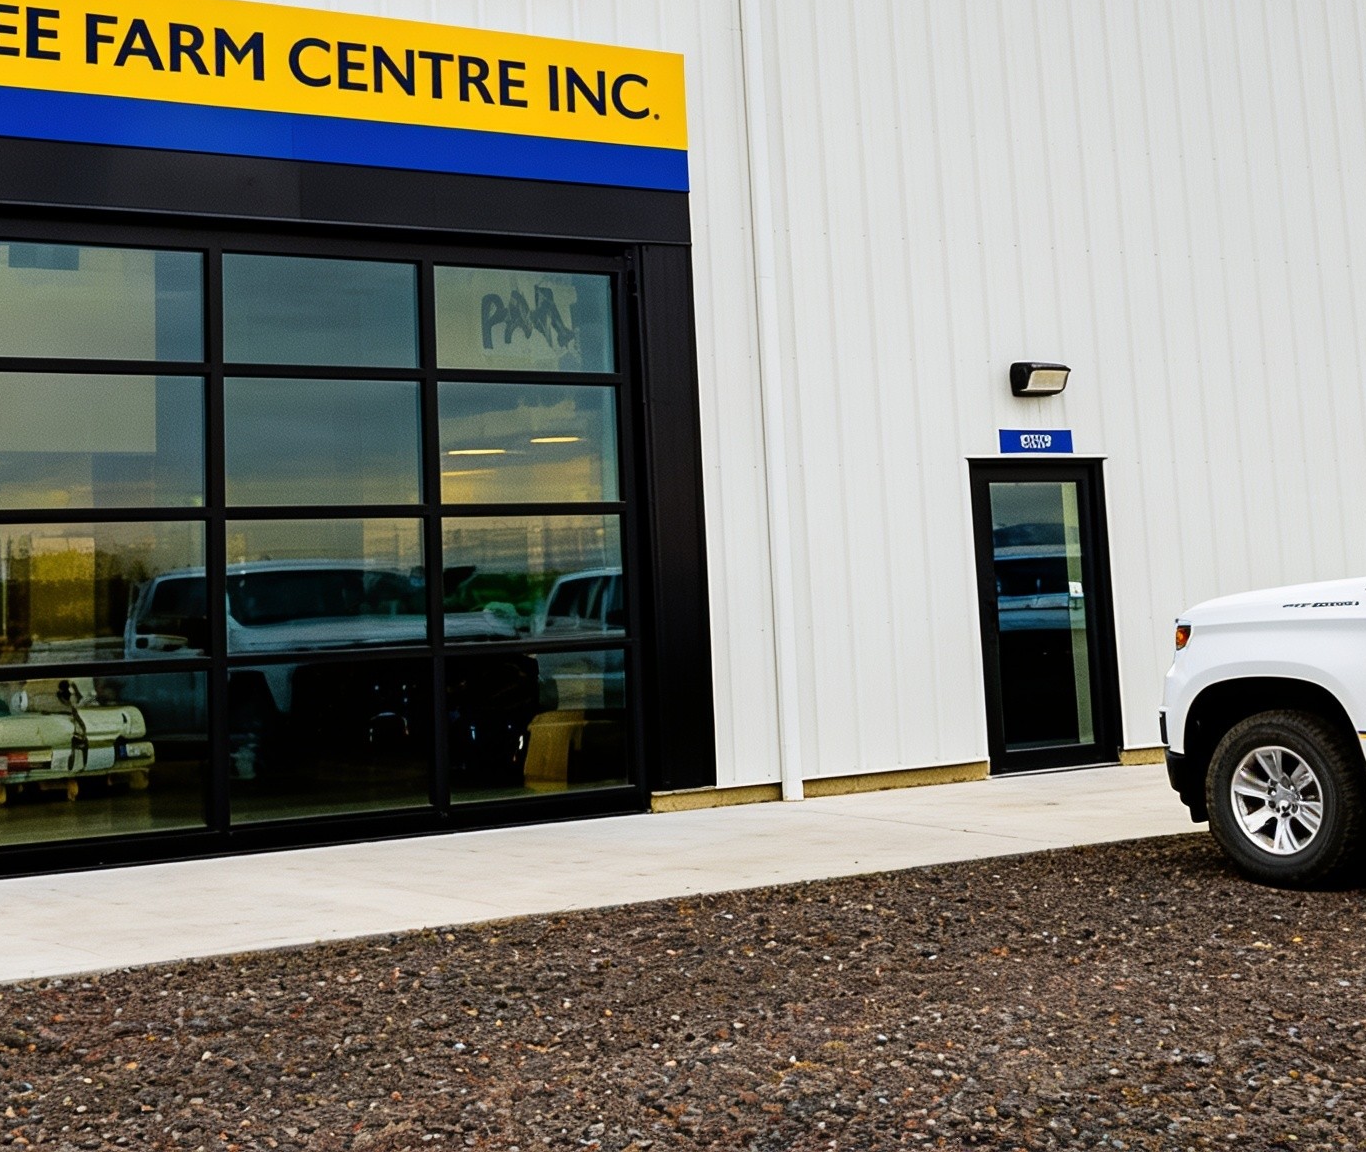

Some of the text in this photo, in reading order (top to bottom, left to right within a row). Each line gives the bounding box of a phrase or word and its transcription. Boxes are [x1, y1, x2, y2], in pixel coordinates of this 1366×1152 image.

[85, 12, 266, 82] FARM
[288, 37, 529, 109] CENTRE
[547, 64, 661, 121] INC.
